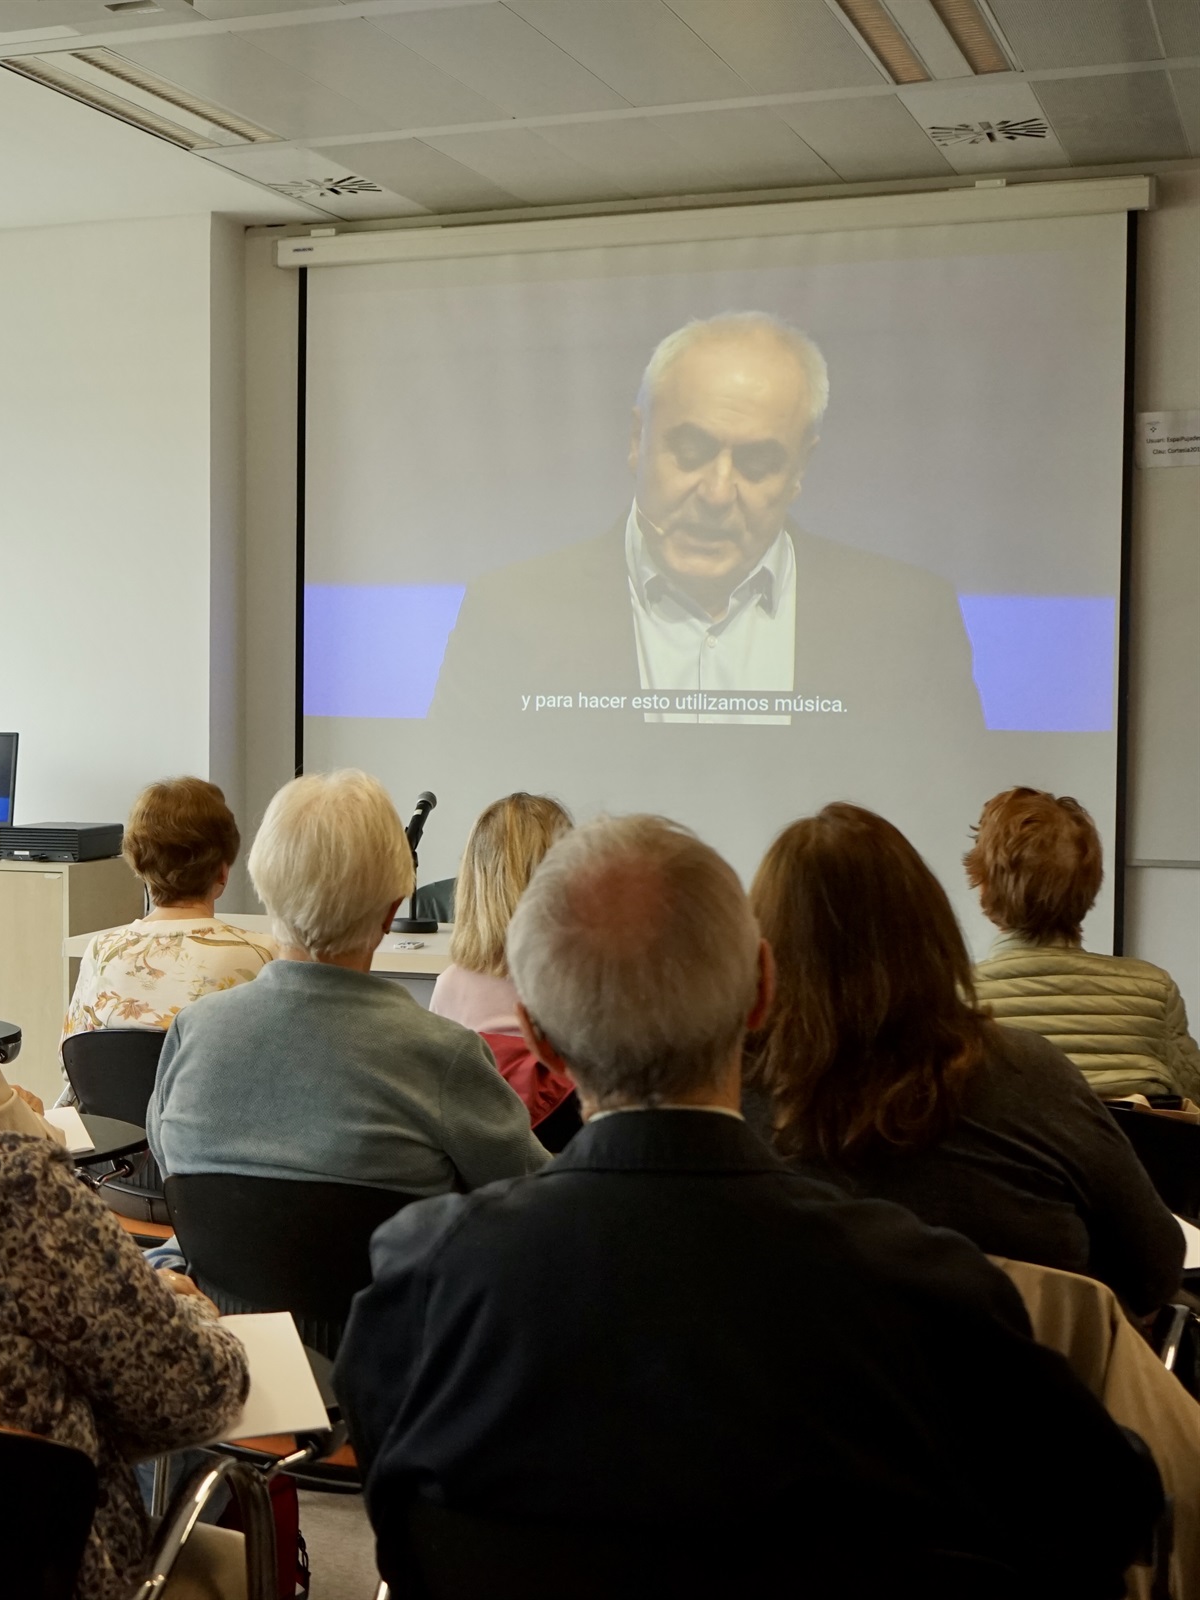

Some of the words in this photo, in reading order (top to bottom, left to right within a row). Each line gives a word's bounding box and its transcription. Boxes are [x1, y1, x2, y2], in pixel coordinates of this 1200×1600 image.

[521, 694, 531, 711] y
[535, 694, 573, 711] para
[578, 692, 627, 709] hacer
[631, 694, 670, 709] esto
[675, 692, 769, 711] utilizamos
[774, 695, 848, 712] música.
